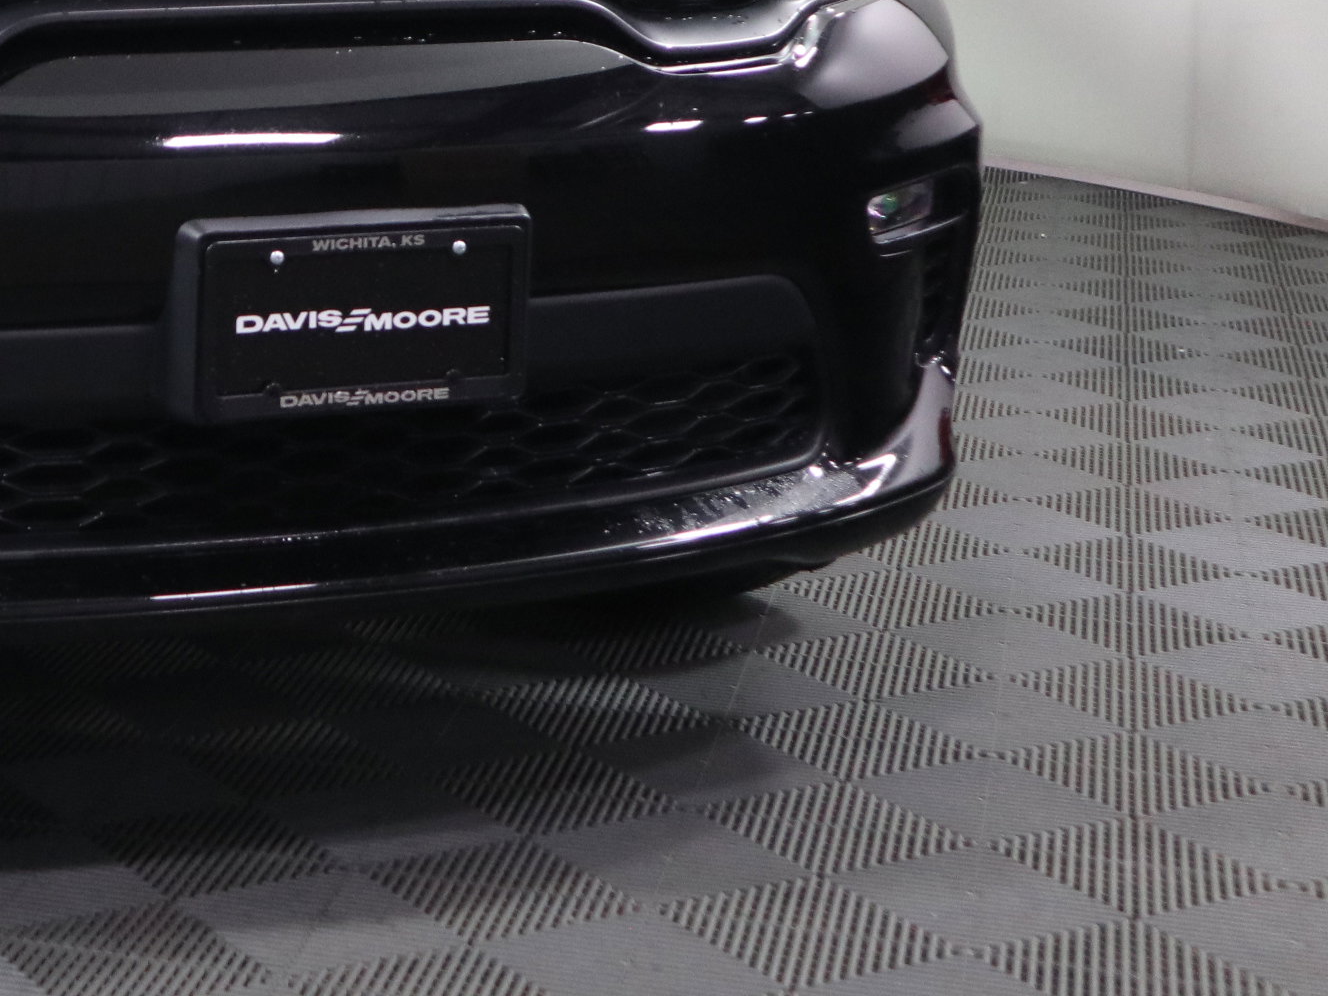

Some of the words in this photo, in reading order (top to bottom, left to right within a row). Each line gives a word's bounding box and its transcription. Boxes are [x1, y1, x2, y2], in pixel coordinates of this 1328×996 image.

[401, 234, 426, 246] KS
[235, 308, 343, 335] DAVIS
[363, 305, 491, 332] MOORE
[280, 390, 351, 409] DAVIS
[364, 387, 451, 406] MOORE
